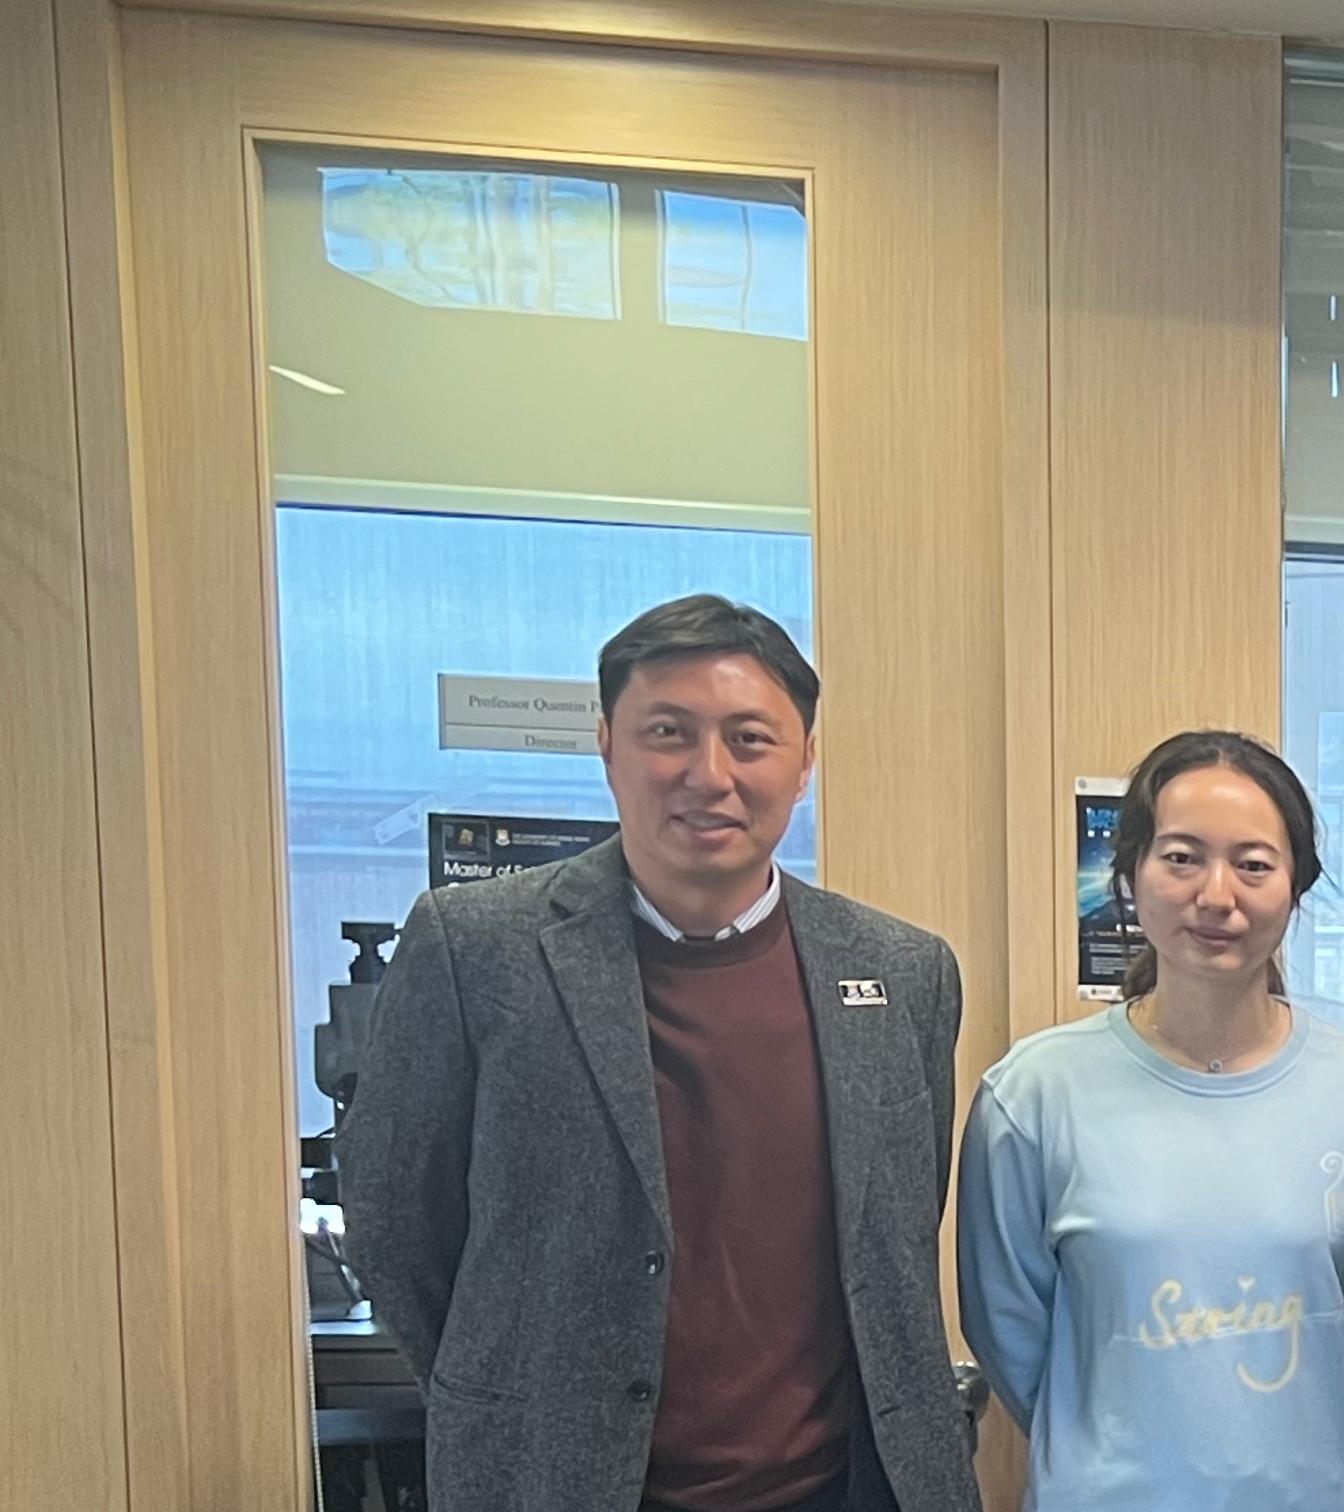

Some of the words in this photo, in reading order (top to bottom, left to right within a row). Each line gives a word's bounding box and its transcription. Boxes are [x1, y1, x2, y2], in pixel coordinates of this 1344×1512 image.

[468, 694, 529, 710] Professor
[533, 697, 586, 713] Quentin
[524, 734, 577, 750] Director
[443, 861, 493, 878] Master
